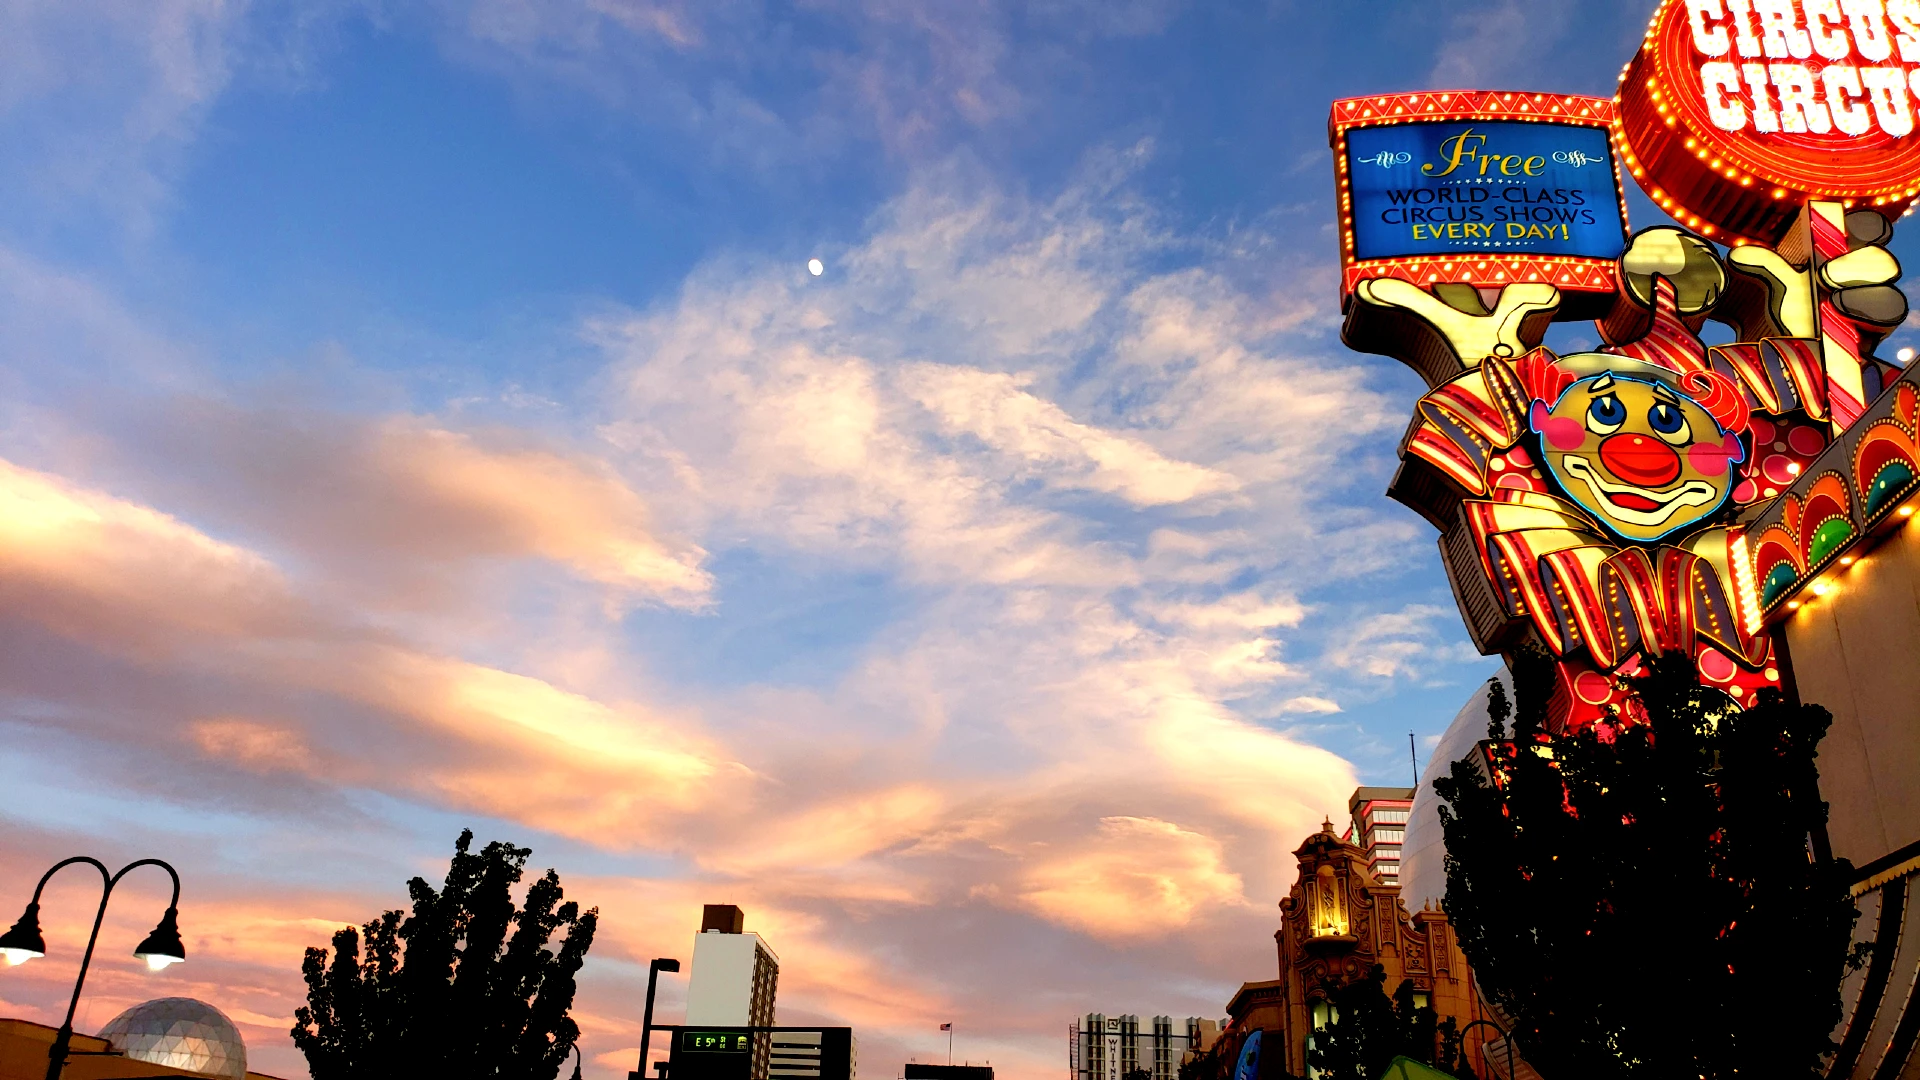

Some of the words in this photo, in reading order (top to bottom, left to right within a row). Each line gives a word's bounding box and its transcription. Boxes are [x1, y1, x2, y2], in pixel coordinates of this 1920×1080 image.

[1685, 0, 1920, 62] CIRCUS
[1700, 62, 1920, 138] CIRCU
[1421, 128, 1545, 177] Free
[1386, 187, 1586, 205] WORLD-CLASS
[1381, 205, 1484, 225] CIRCUS
[1494, 206, 1596, 225] SHOWS
[1412, 223, 1495, 240] EVERY
[1506, 223, 1569, 240] DAY!
[695, 1037, 701, 1047] E
